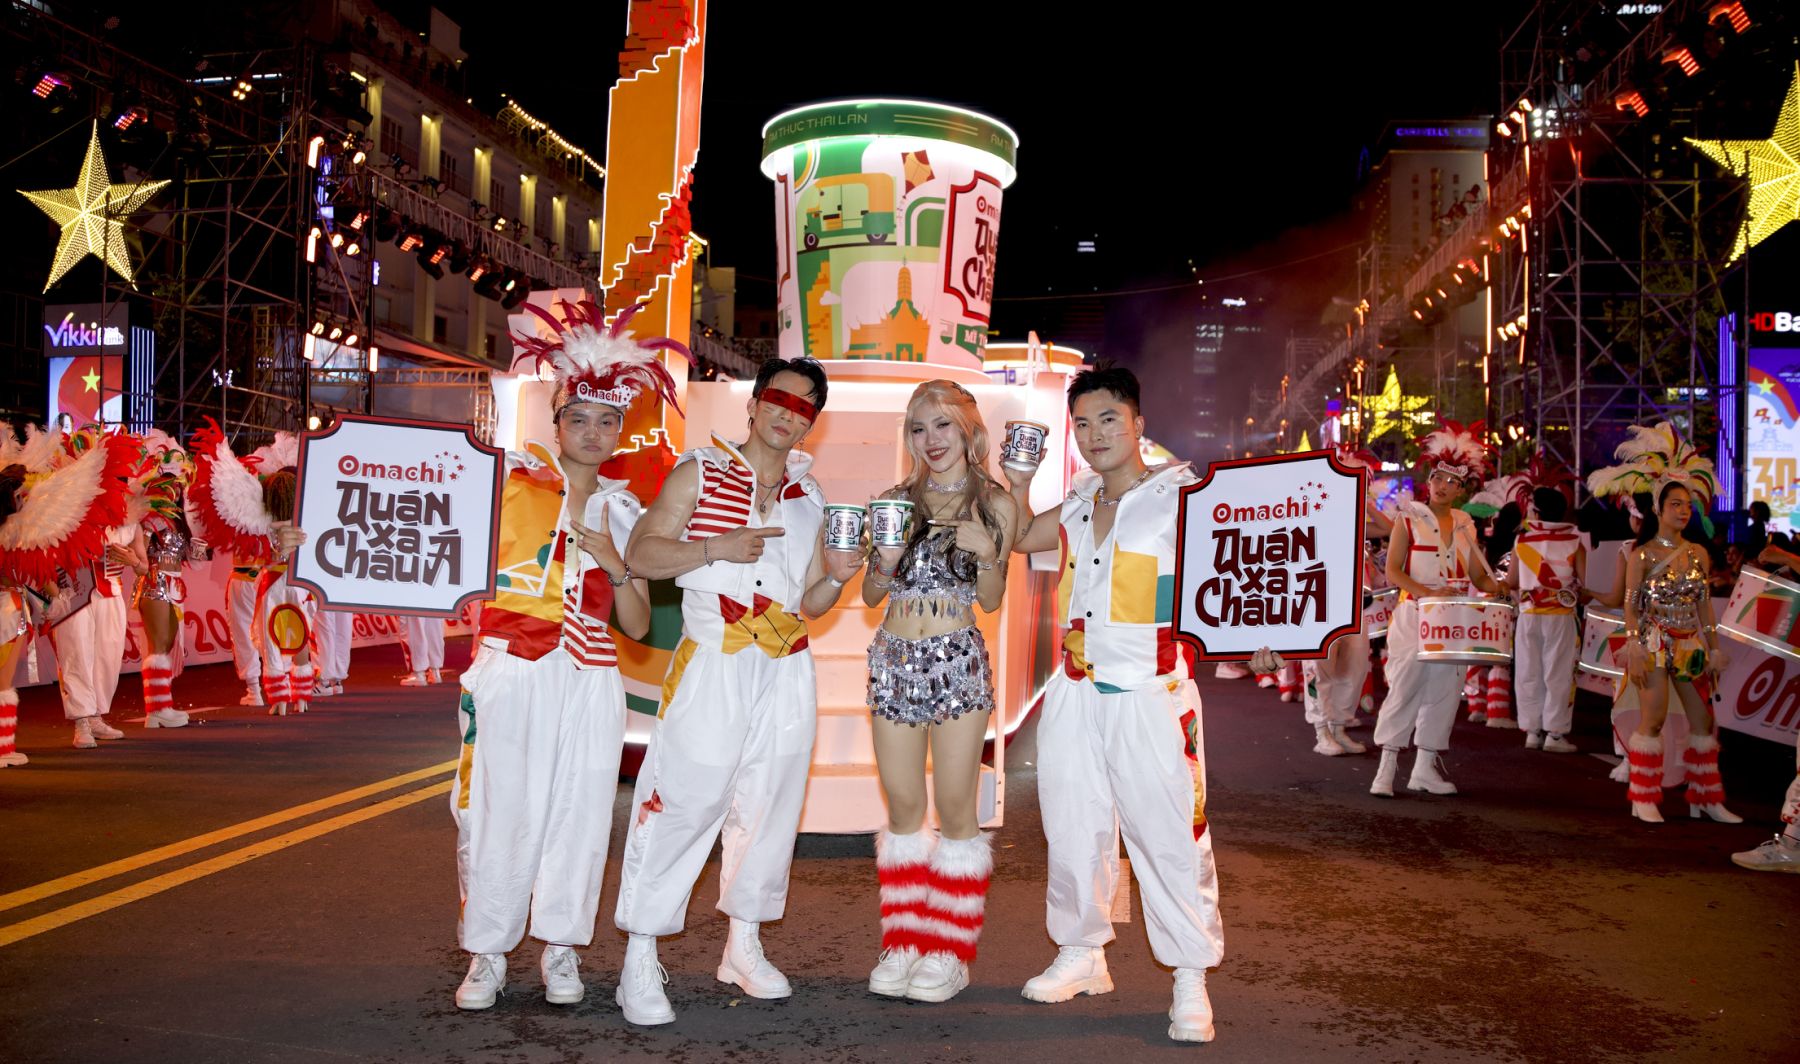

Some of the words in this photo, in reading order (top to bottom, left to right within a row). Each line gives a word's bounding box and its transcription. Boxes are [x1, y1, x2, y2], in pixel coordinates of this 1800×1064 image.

[44, 312, 97, 346] Vikki
[1748, 312, 1800, 332] HDBa
[579, 383, 622, 403] Omachi
[338, 455, 444, 483] Omachi
[1213, 495, 1309, 524] Omachi
[366, 521, 421, 554] xá
[315, 527, 419, 583] Châu
[422, 528, 462, 586] Á
[1239, 560, 1289, 595] xá
[1195, 576, 1288, 628] Châu
[1290, 561, 1327, 626] Á
[1420, 620, 1500, 641] Omachi
